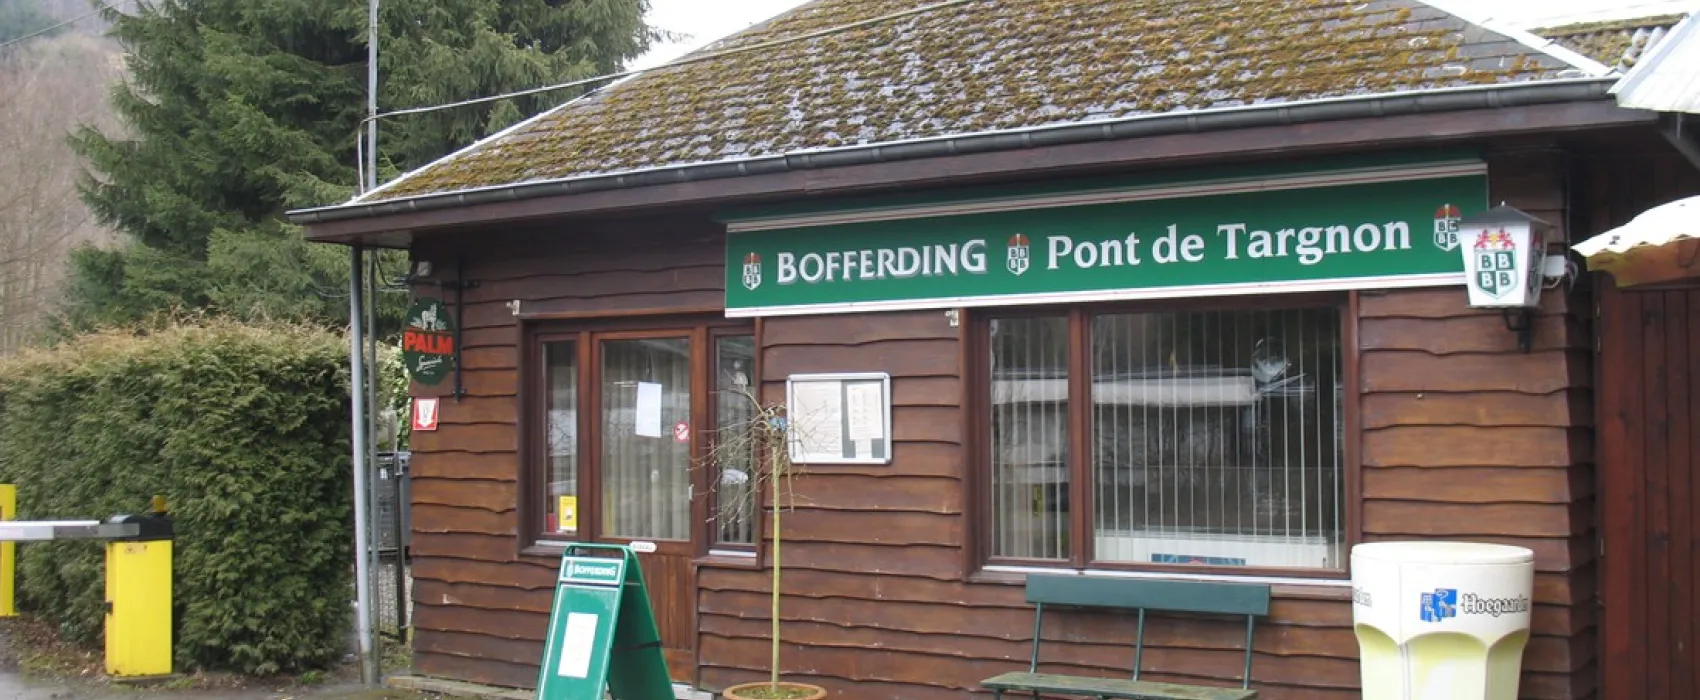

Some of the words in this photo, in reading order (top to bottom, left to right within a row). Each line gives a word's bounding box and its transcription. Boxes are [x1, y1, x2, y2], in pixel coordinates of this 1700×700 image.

[777, 239, 987, 284] BOFFERDING
[1046, 231, 1142, 270] Pont
[1152, 223, 1205, 264] de
[1216, 220, 1412, 266] Targnon
[404, 330, 454, 355] PALM
